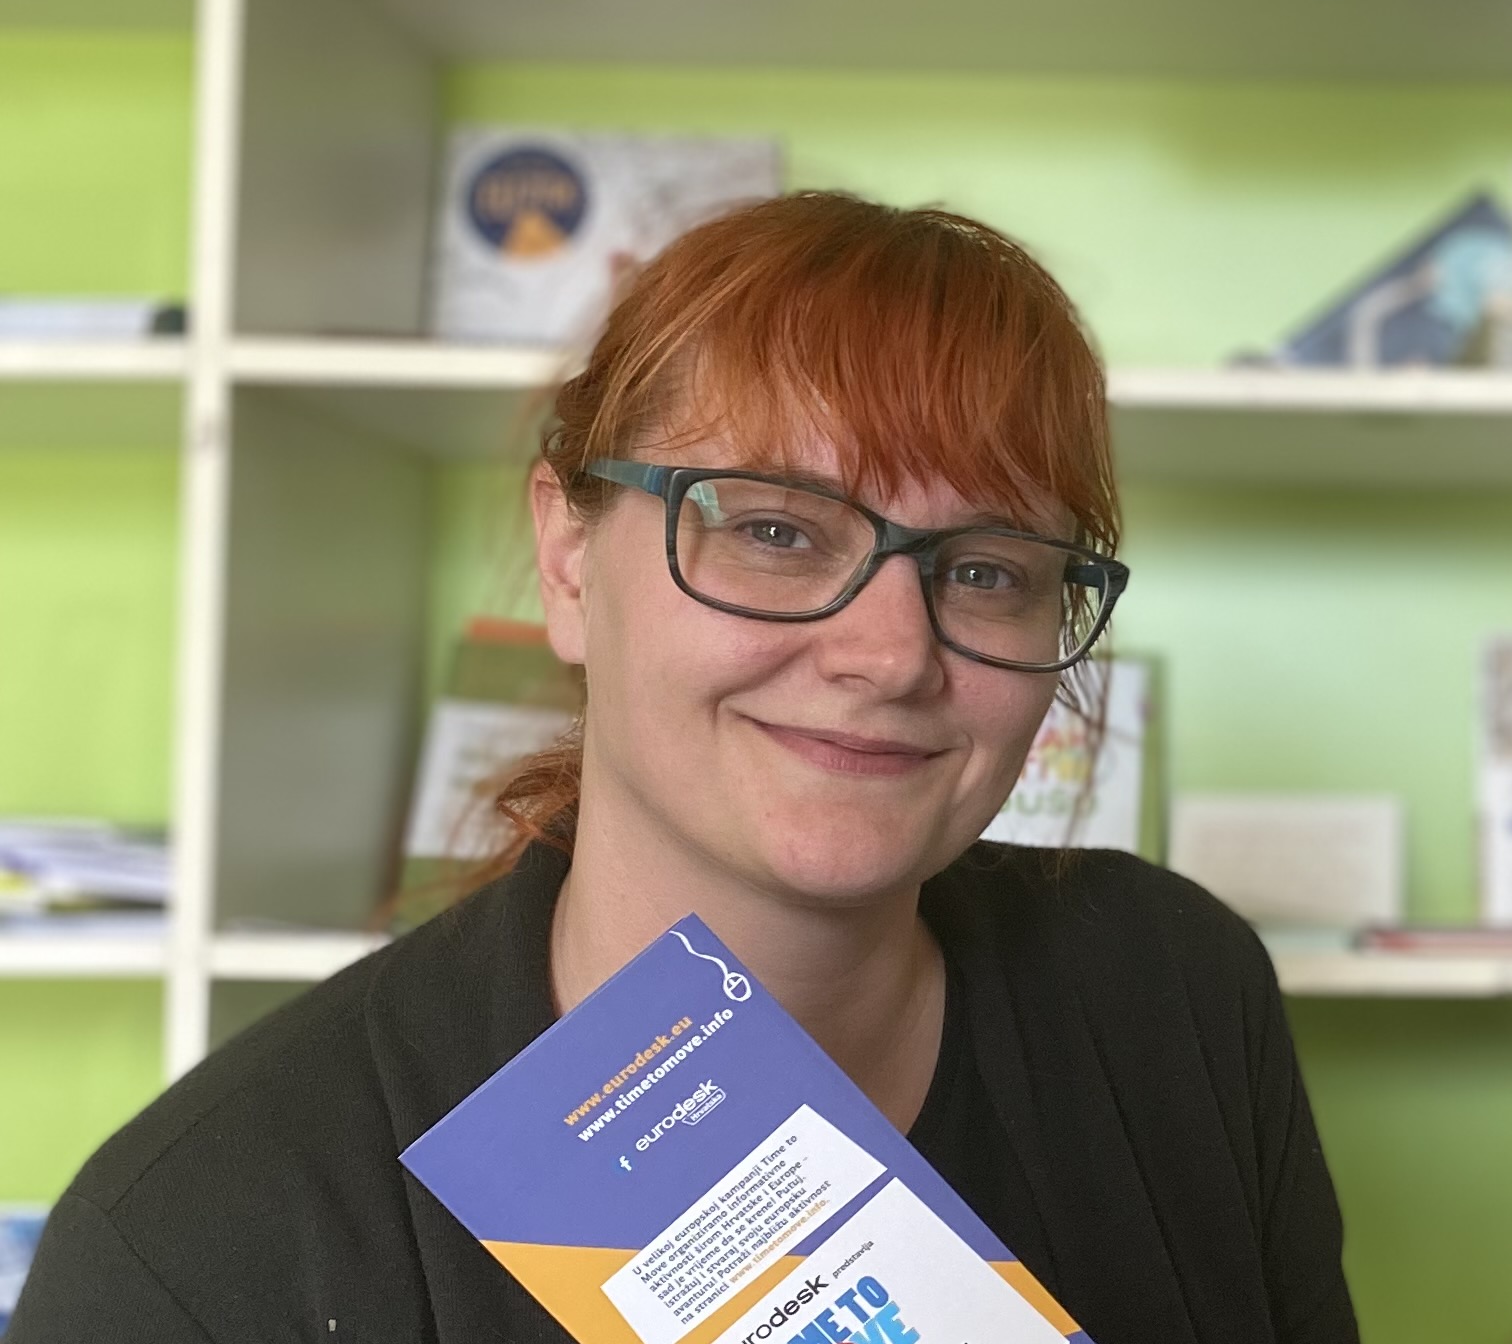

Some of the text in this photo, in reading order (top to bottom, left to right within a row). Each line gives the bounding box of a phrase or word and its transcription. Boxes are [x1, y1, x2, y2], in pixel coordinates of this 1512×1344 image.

[562, 1016, 693, 1126] www.eurodesk.eu
[577, 1008, 733, 1141] www.timetomove.info
[635, 1078, 718, 1151] eurodesk
[631, 1134, 797, 1275] U velikoj europskoj kampanji Time to
[640, 1159, 786, 1284] Move organiziramo informativne
[648, 1251, 695, 1292] aktivnosti
[720, 1194, 763, 1231] Hrvatske
[767, 1160, 802, 1191] Europe
[705, 1244, 740, 1274] stvaraj
[737, 1223, 764, 1247] svoju
[763, 1186, 807, 1225] europsku
[787, 1179, 832, 1219] aktivnost
[656, 1282, 676, 1300] sad
[673, 1275, 686, 1288] je
[684, 1245, 721, 1276] vrijeme
[720, 1234, 735, 1246] da
[734, 1223, 746, 1235] se
[831, 1240, 875, 1279] predstavlja
[833, 1275, 889, 1324] TO
[680, 1312, 695, 1325] na
[694, 1281, 730, 1314] stranici
